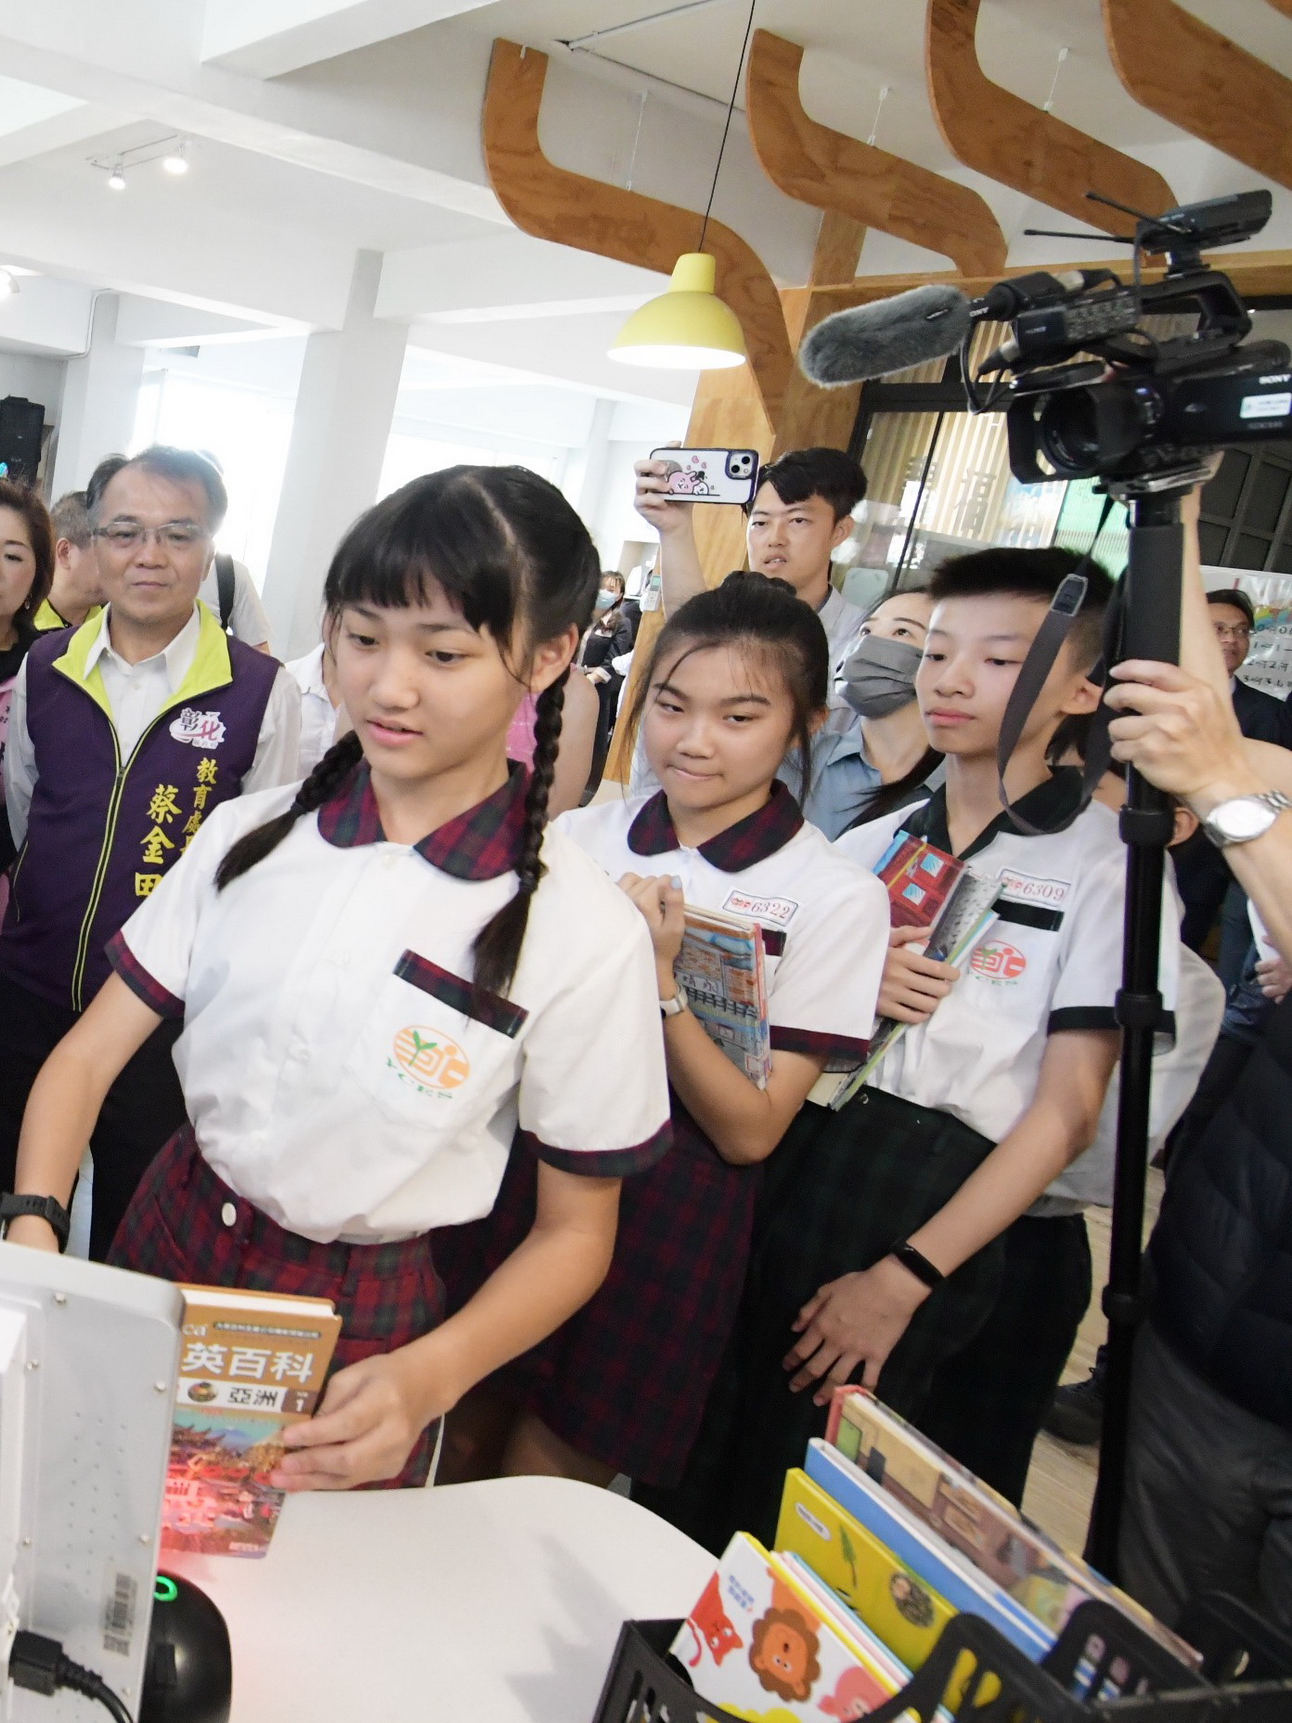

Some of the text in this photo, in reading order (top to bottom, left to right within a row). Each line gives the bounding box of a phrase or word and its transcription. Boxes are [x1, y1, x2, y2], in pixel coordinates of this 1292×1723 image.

[968, 306, 990, 318] ONY
[180, 707, 221, 742] 彰化
[134, 783, 183, 898] 蔡金田
[1022, 881, 1065, 901] 6309
[751, 901, 791, 919] 6322
[180, 1341, 314, 1384] 英百科
[227, 1386, 279, 1407] 亞洲
[296, 1398, 305, 1412] 1
